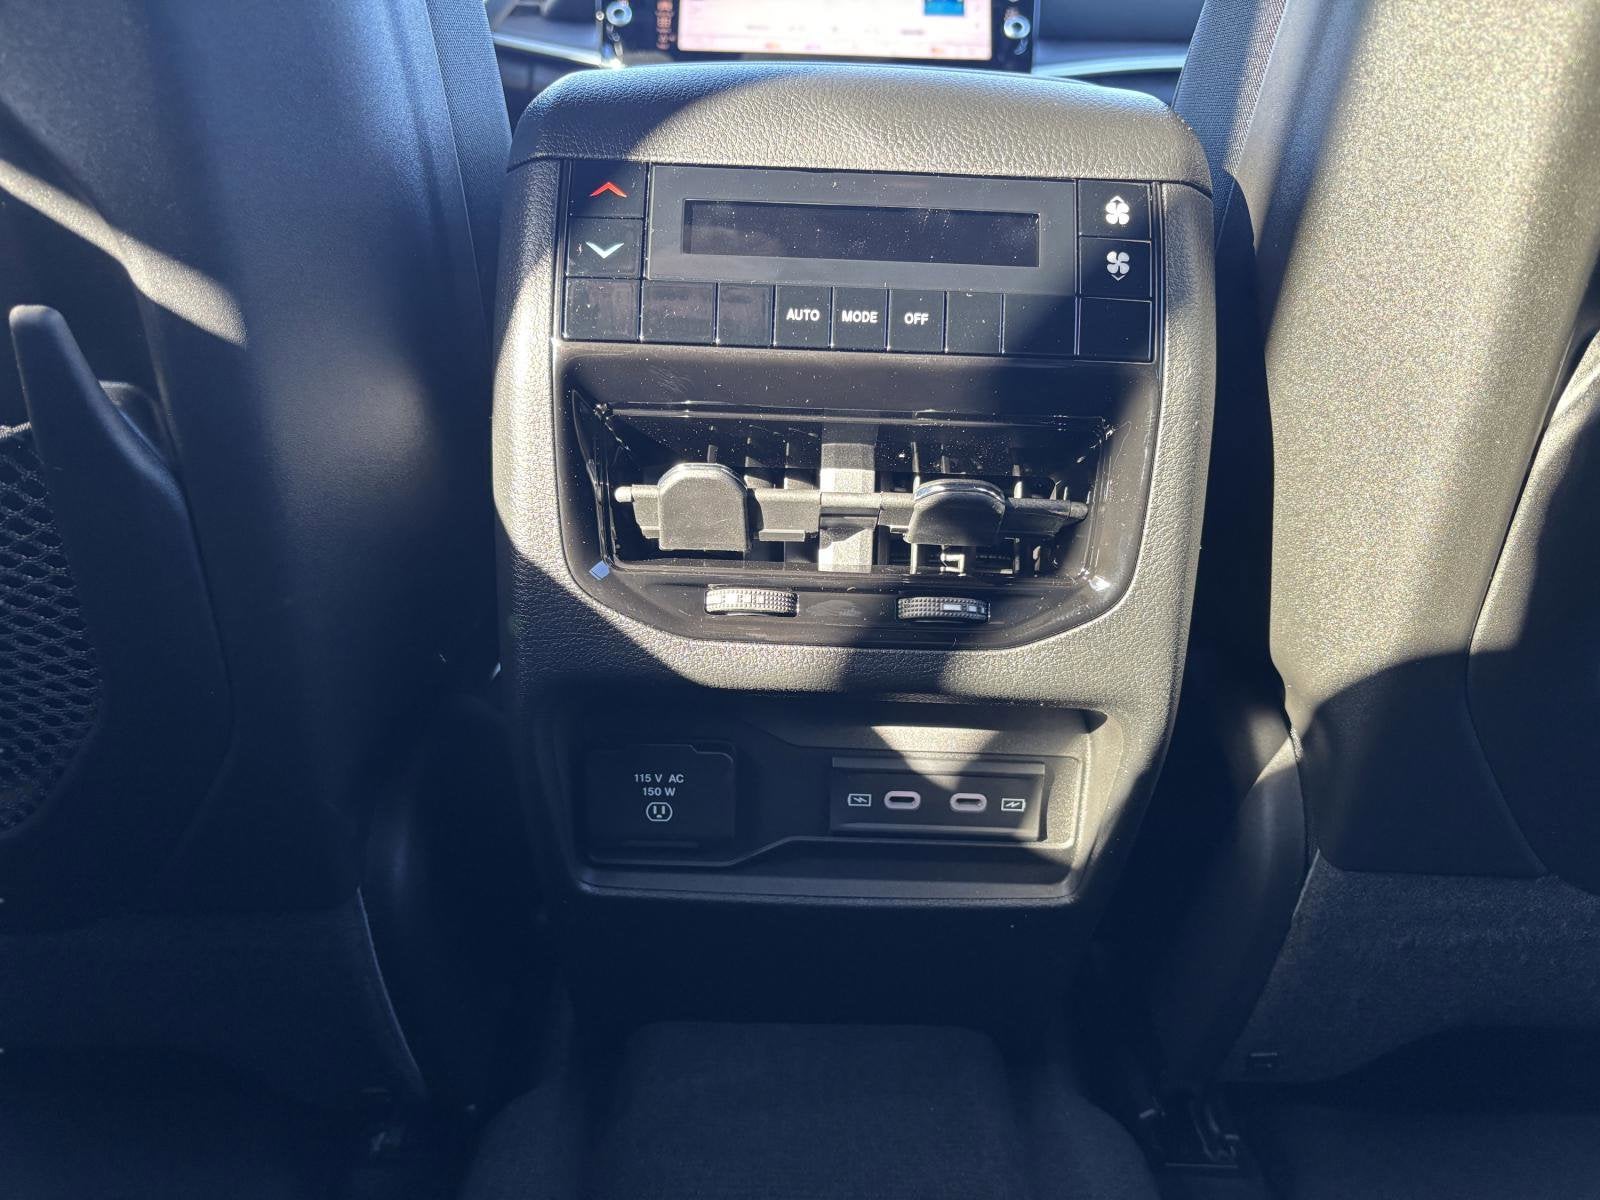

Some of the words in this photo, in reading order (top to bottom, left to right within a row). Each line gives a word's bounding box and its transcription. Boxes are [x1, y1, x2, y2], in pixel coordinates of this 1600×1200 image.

[785, 307, 821, 322] AUTO
[841, 309, 879, 324] MODE
[903, 311, 930, 326] OFF
[634, 773, 652, 783] 115
[654, 773, 663, 783] V
[668, 773, 685, 784] AC
[642, 787, 662, 797] 150
[664, 787, 676, 797] W
